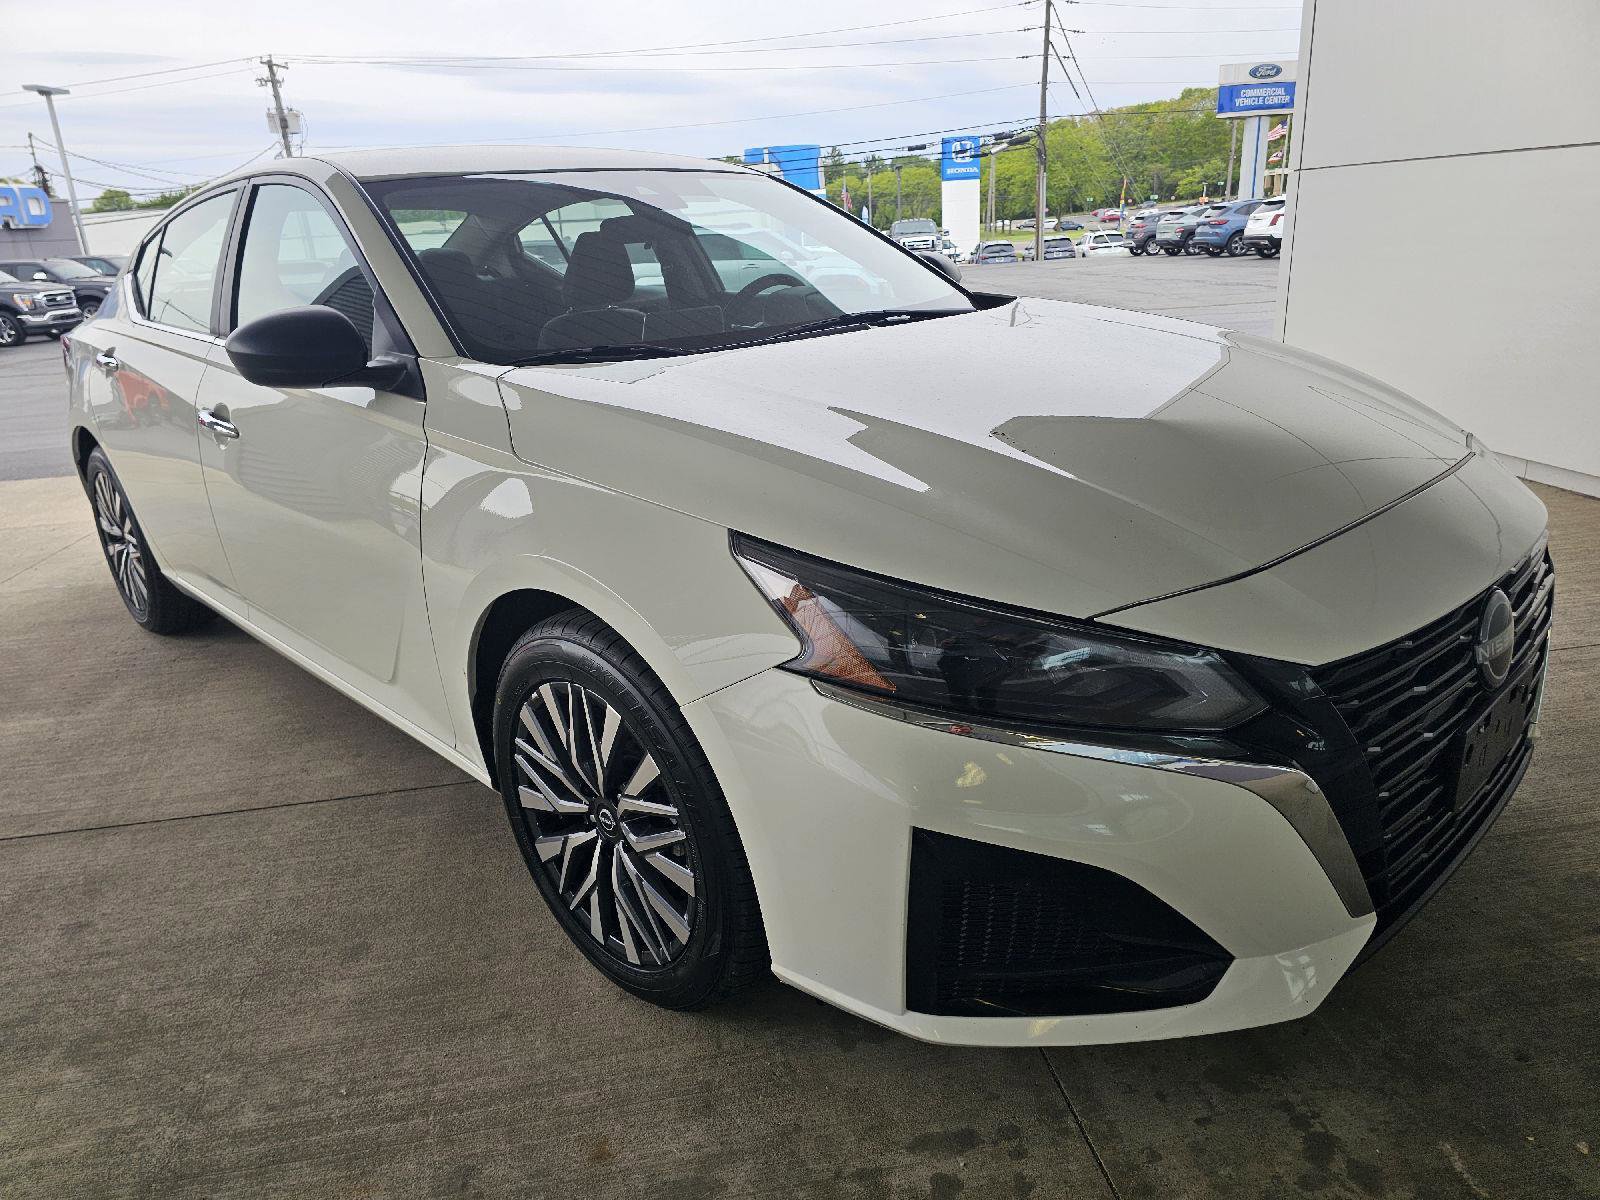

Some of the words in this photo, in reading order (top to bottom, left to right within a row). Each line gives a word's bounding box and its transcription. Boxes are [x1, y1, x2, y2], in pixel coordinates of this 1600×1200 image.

[1240, 87, 1286, 98] COMMERCIAL
[1235, 96, 1264, 107] VEHICLE
[1265, 95, 1290, 105] CENTER
